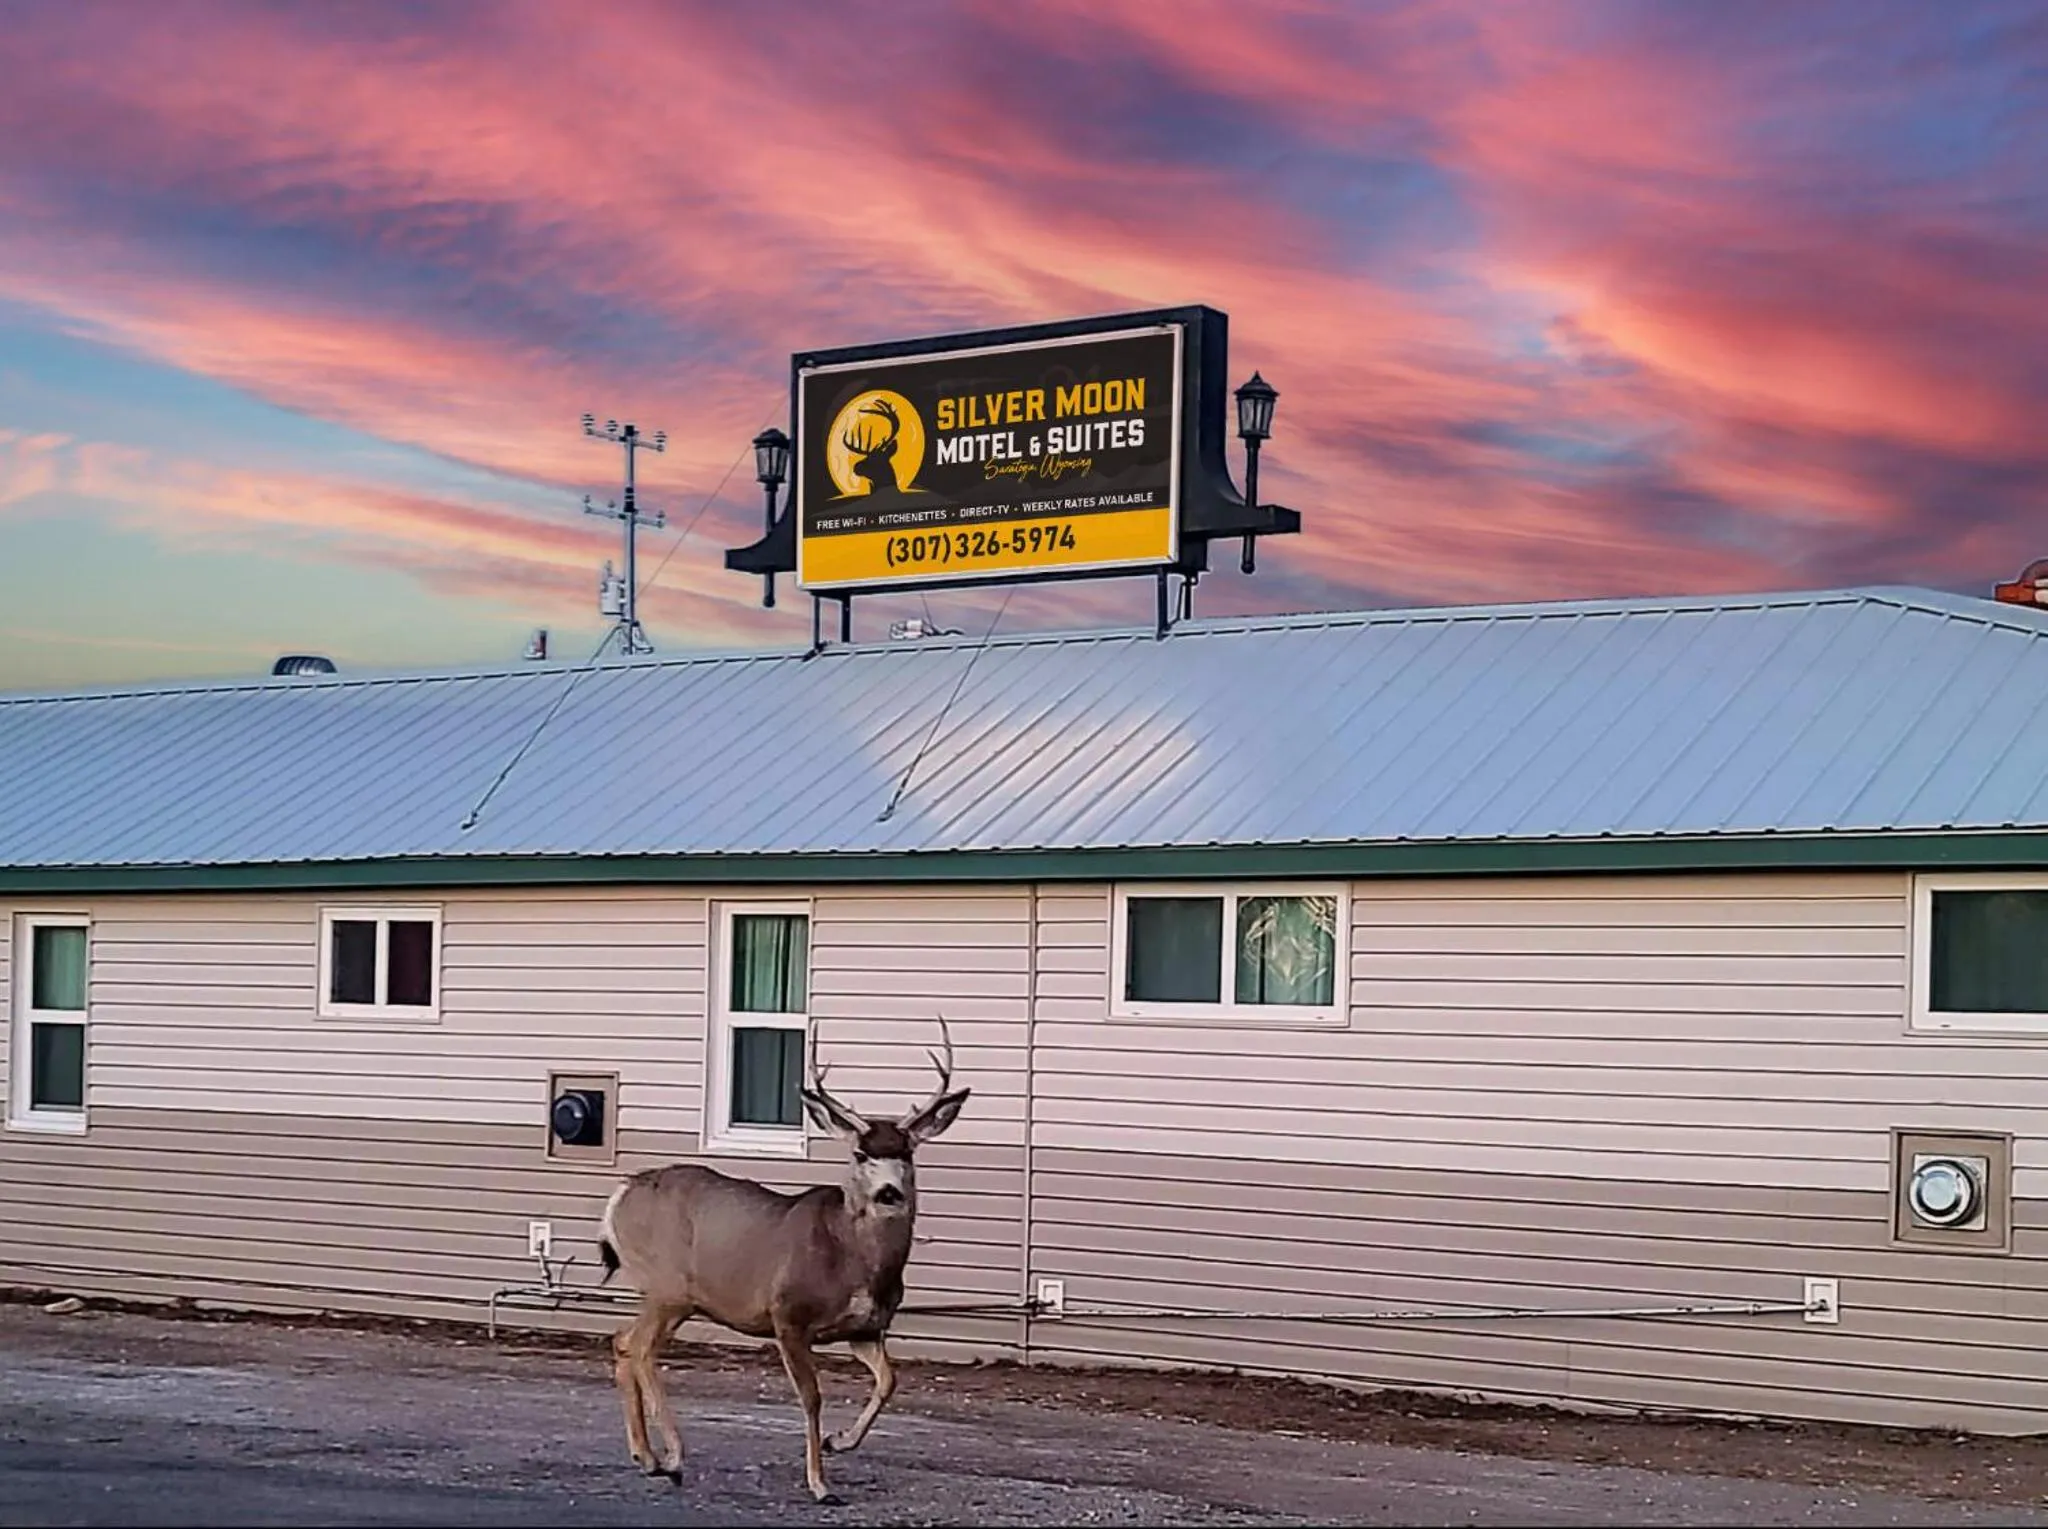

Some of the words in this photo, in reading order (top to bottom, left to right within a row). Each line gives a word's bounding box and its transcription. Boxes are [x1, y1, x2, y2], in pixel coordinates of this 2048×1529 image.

[937, 389, 1047, 431] SILVER
[1055, 377, 1146, 417] MOON
[936, 431, 1022, 465] MOTEL
[1029, 436, 1040, 455] &
[1047, 419, 1145, 455] SUITES
[1040, 454, 1093, 481] Wyoming
[816, 519, 840, 530] FREE
[841, 516, 866, 528] WI-FI
[878, 510, 947, 525] KITCHENETTES
[960, 505, 1010, 518] DIRECT-TV
[1022, 499, 1063, 512] WEEKLY
[1064, 496, 1096, 509] RATES
[1098, 492, 1154, 507] AVAILABLE
